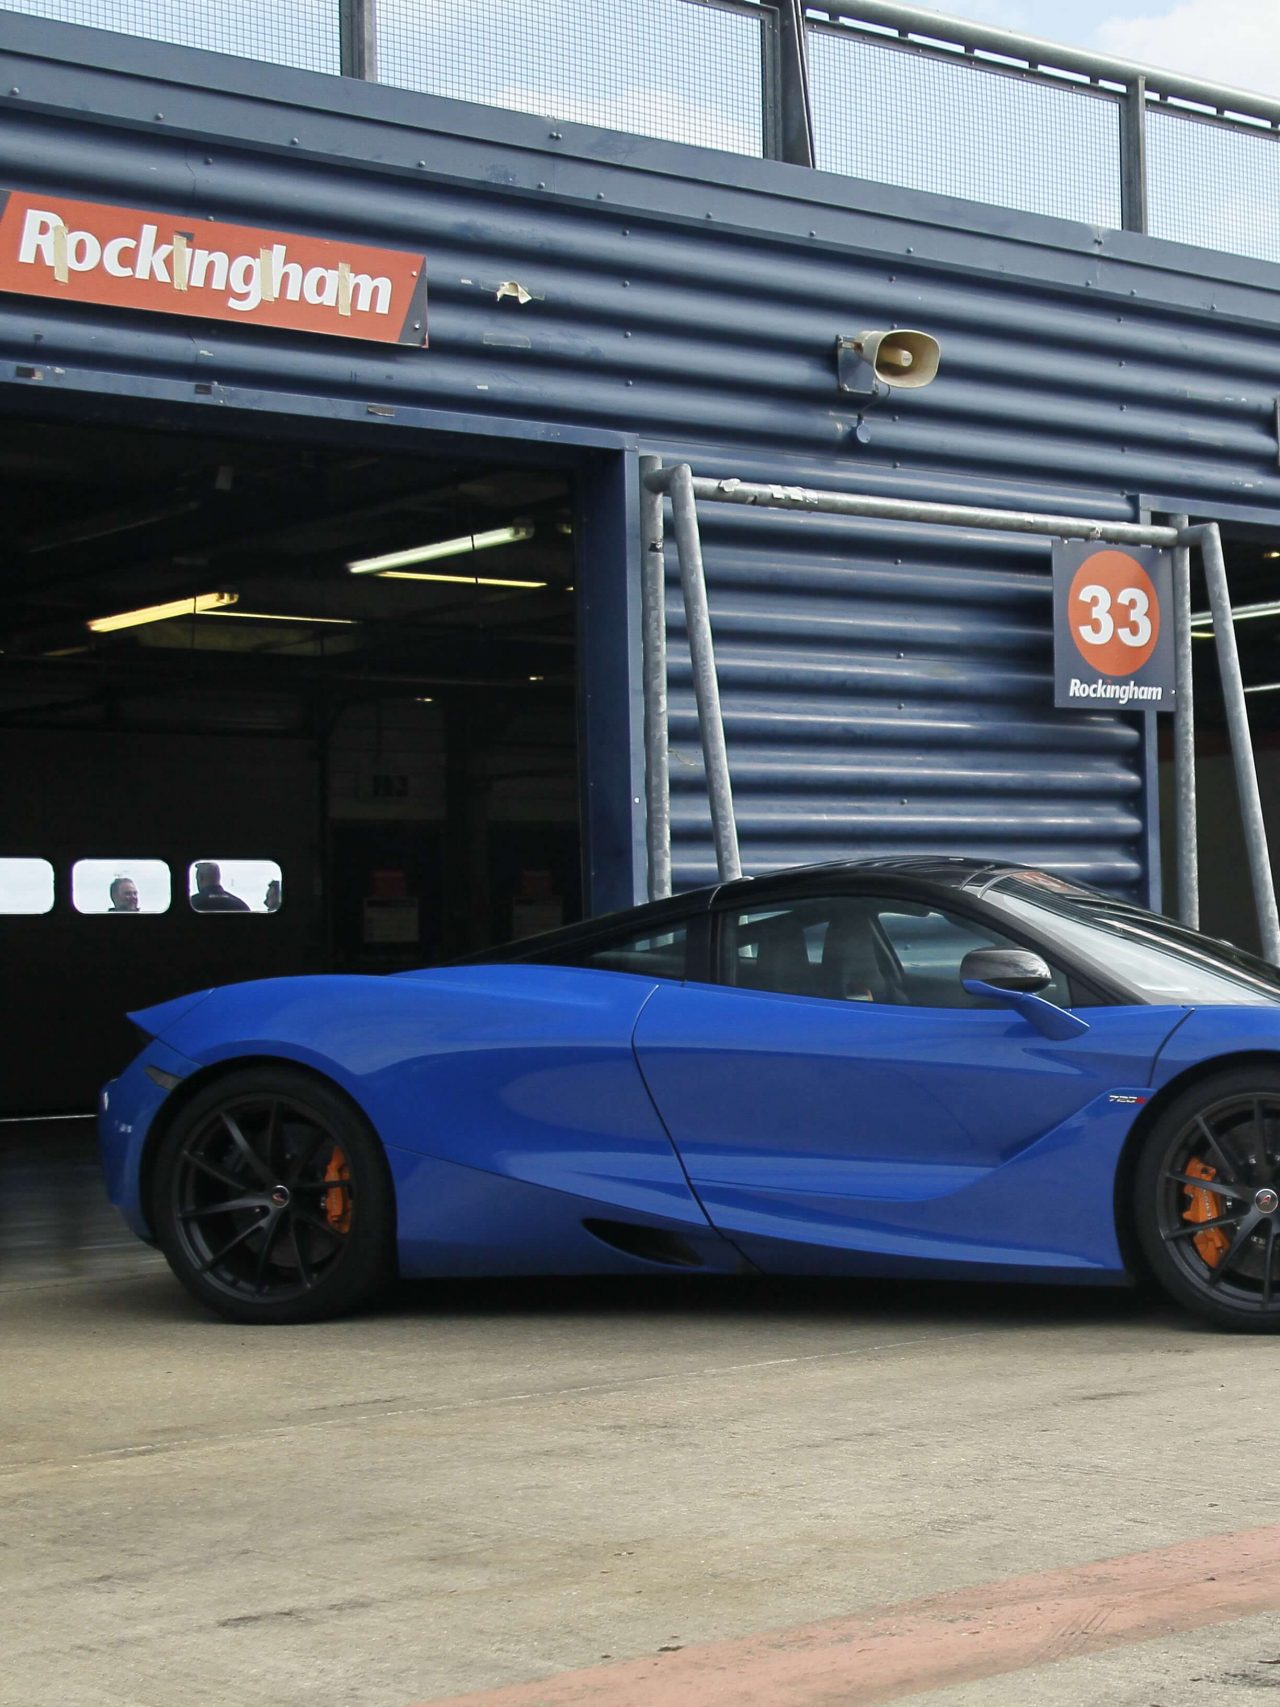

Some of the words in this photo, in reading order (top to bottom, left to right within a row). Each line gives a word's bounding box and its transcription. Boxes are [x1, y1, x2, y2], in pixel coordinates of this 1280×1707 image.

[19, 209, 392, 314] Rockingham
[1079, 585, 1151, 647] 33
[1070, 679, 1162, 704] Rockingham
